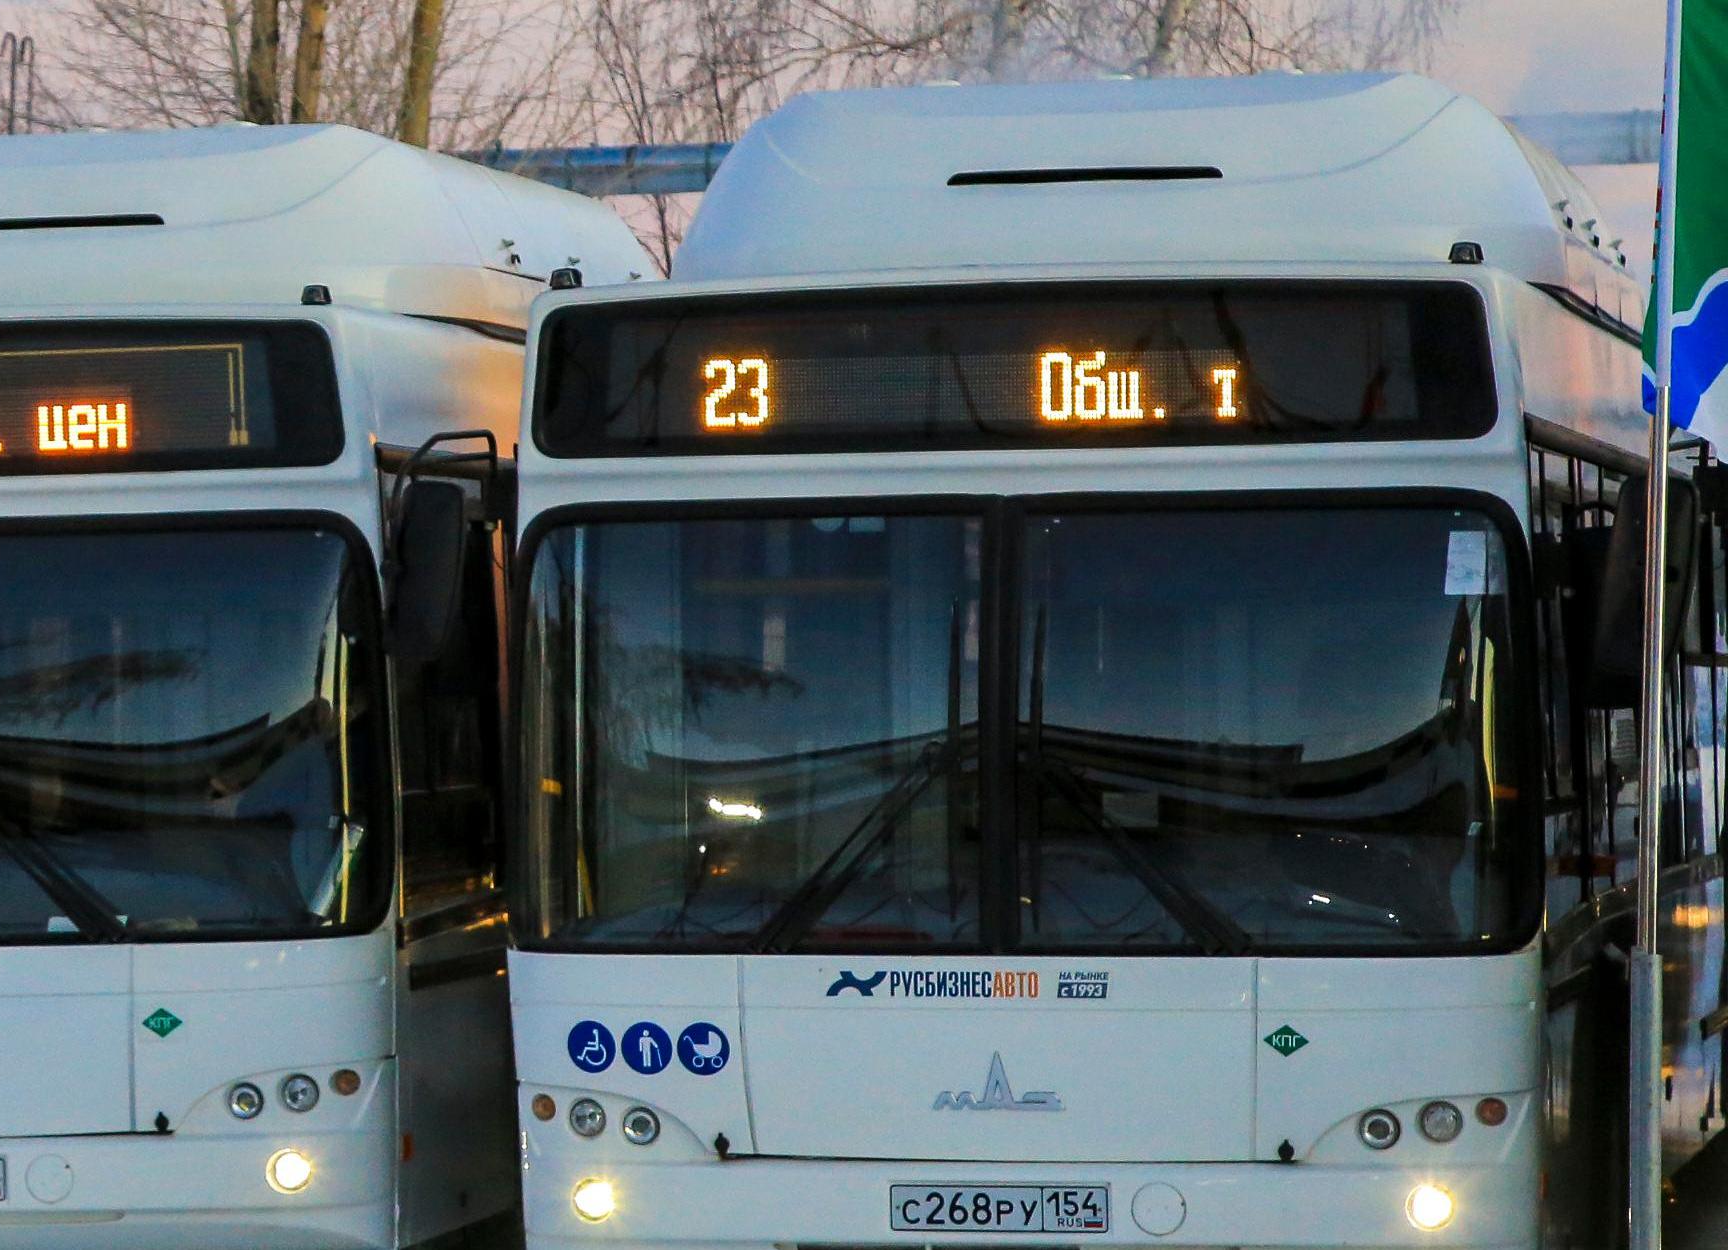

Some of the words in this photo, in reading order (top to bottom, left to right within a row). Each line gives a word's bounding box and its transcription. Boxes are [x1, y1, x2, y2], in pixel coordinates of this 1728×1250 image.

[705, 358, 768, 427] 23
[38, 403, 127, 450] цен
[890, 971, 1039, 998] РУСБИЗНЕСАВТО
[1072, 984, 1103, 997] 1993
[1272, 1034, 1301, 1047] КПГ
[1046, 1190, 1098, 1217] 154
[1058, 1217, 1083, 1228] RUS
